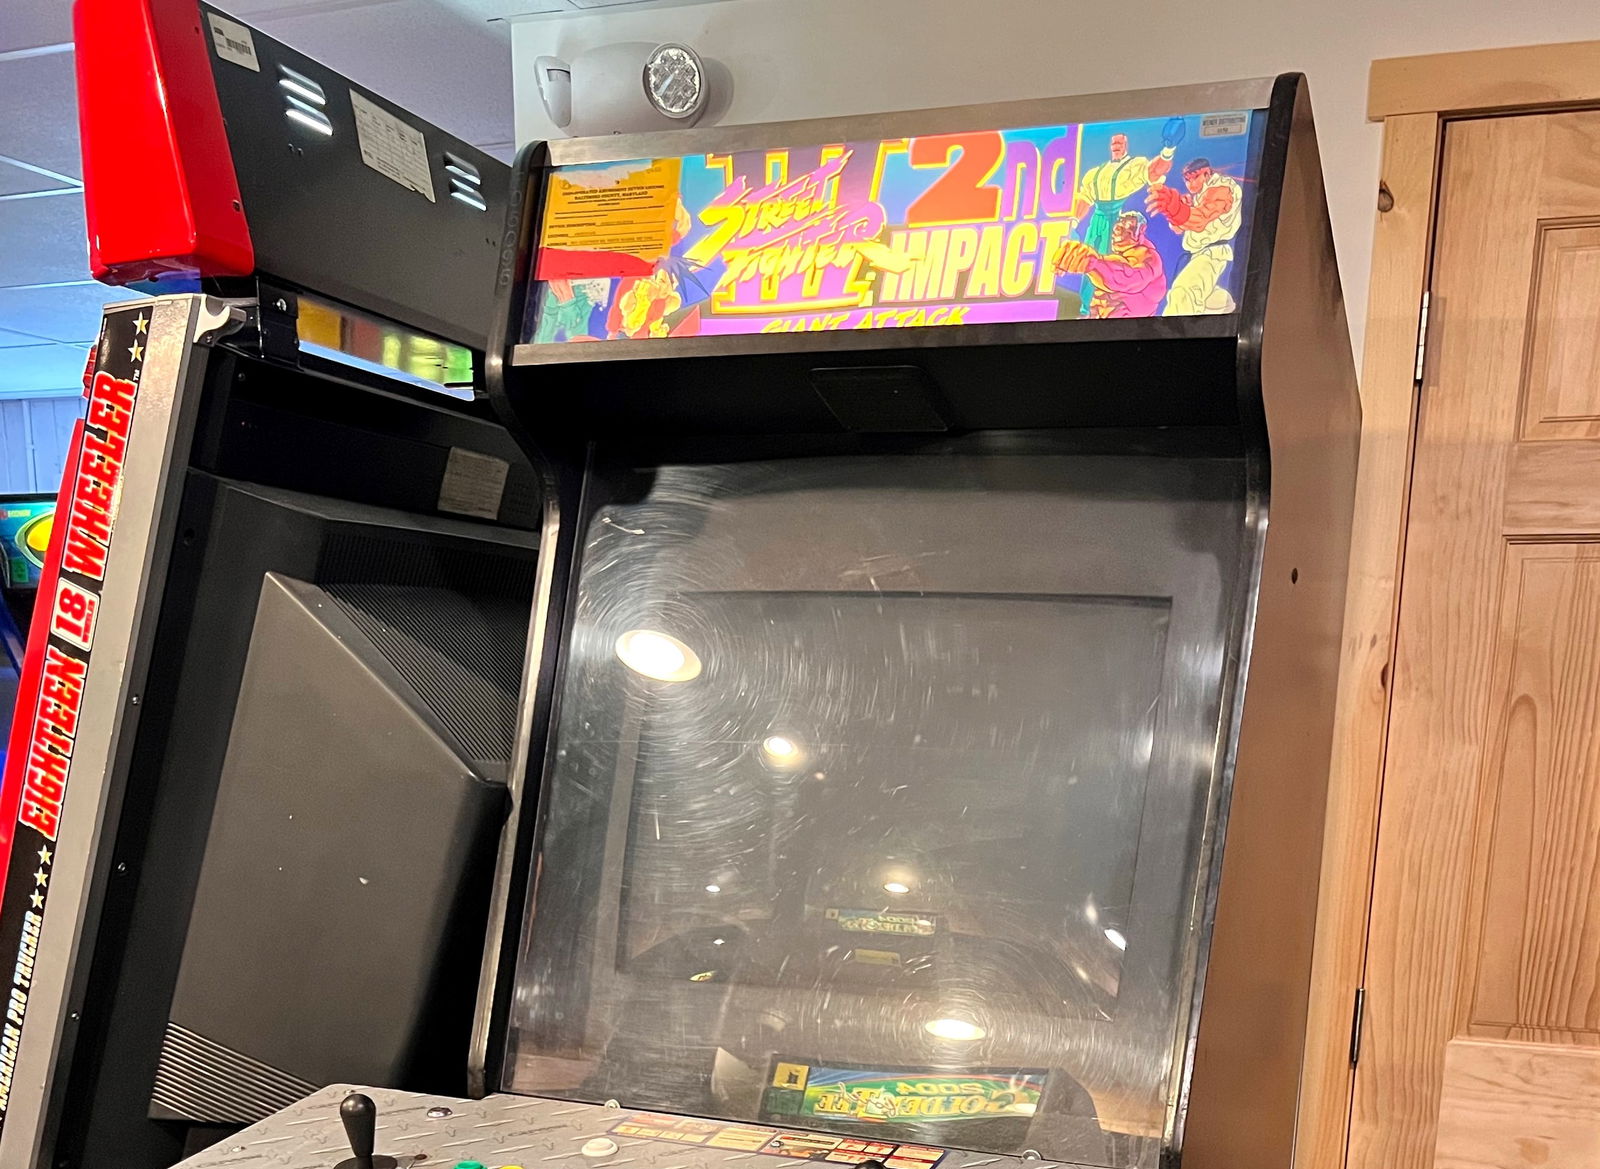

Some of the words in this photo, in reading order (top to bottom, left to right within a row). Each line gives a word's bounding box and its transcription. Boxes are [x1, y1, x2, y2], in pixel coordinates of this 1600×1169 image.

[683, 150, 853, 266] STREET
[904, 123, 1083, 228] 2nd
[878, 219, 1072, 302] IMPACT
[62, 371, 138, 581] WHEELER
[55, 587, 88, 638] 18
[19, 645, 87, 841] EIGHTEEN
[13, 910, 42, 988] TRUCKER
[7, 987, 28, 1025] PRO
